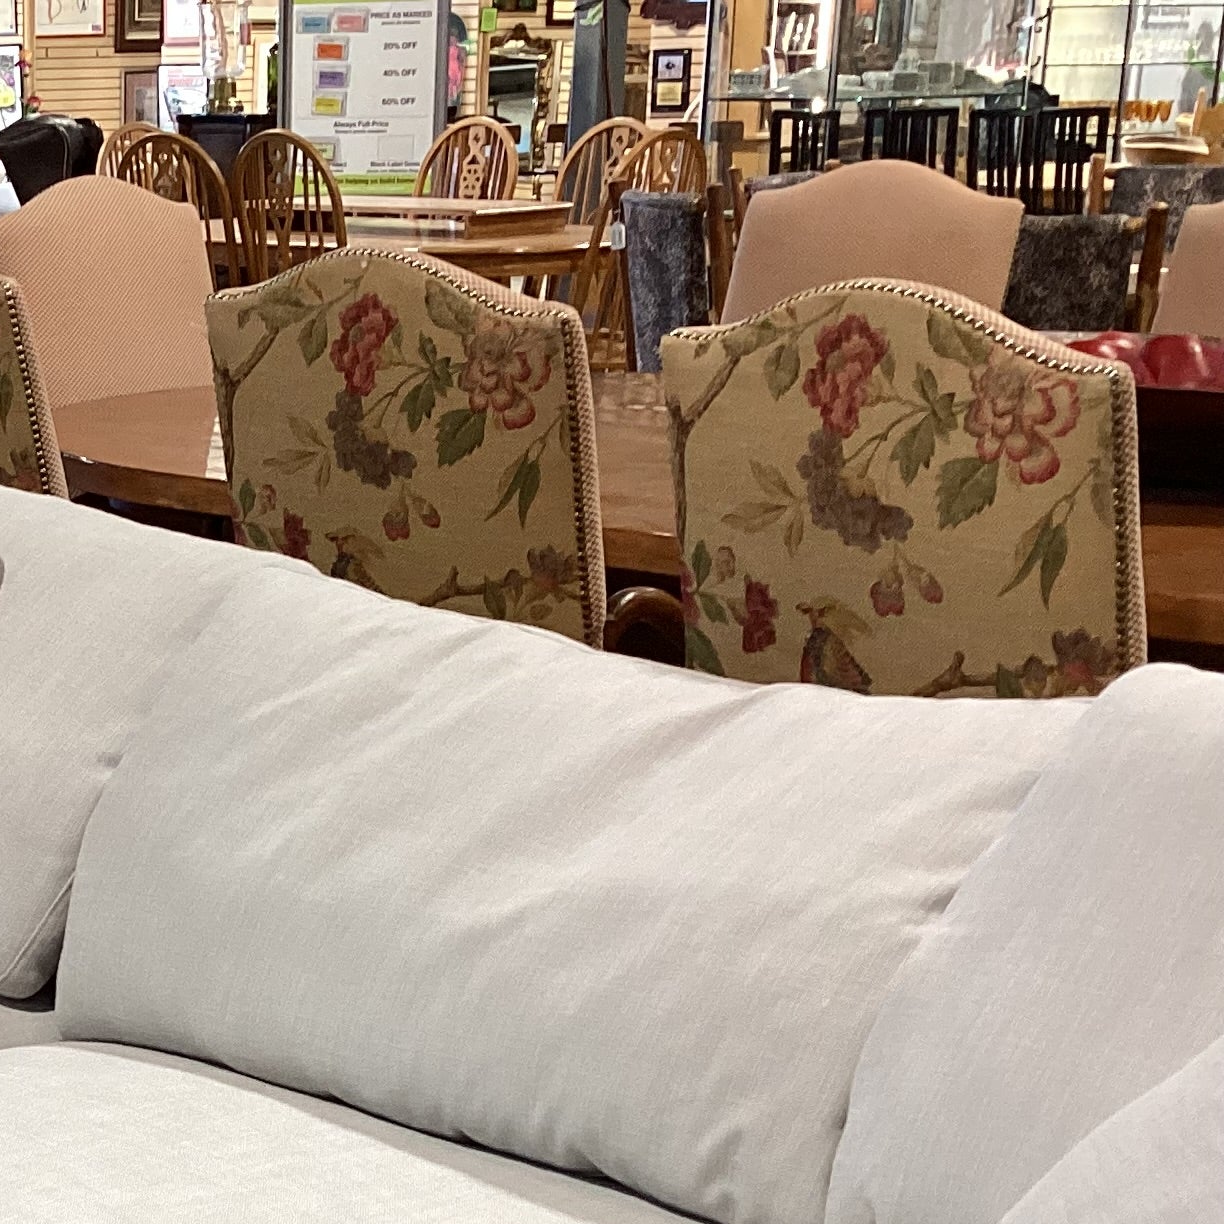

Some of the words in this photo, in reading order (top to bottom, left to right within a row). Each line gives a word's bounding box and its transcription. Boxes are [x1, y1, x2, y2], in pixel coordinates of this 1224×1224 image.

[403, 10, 433, 18] MARKED
[383, 42, 400, 50] 20%
[401, 42, 418, 50] OFF
[401, 69, 417, 77] OFF
[381, 98, 398, 106] 60%
[400, 97, 416, 105] OFF
